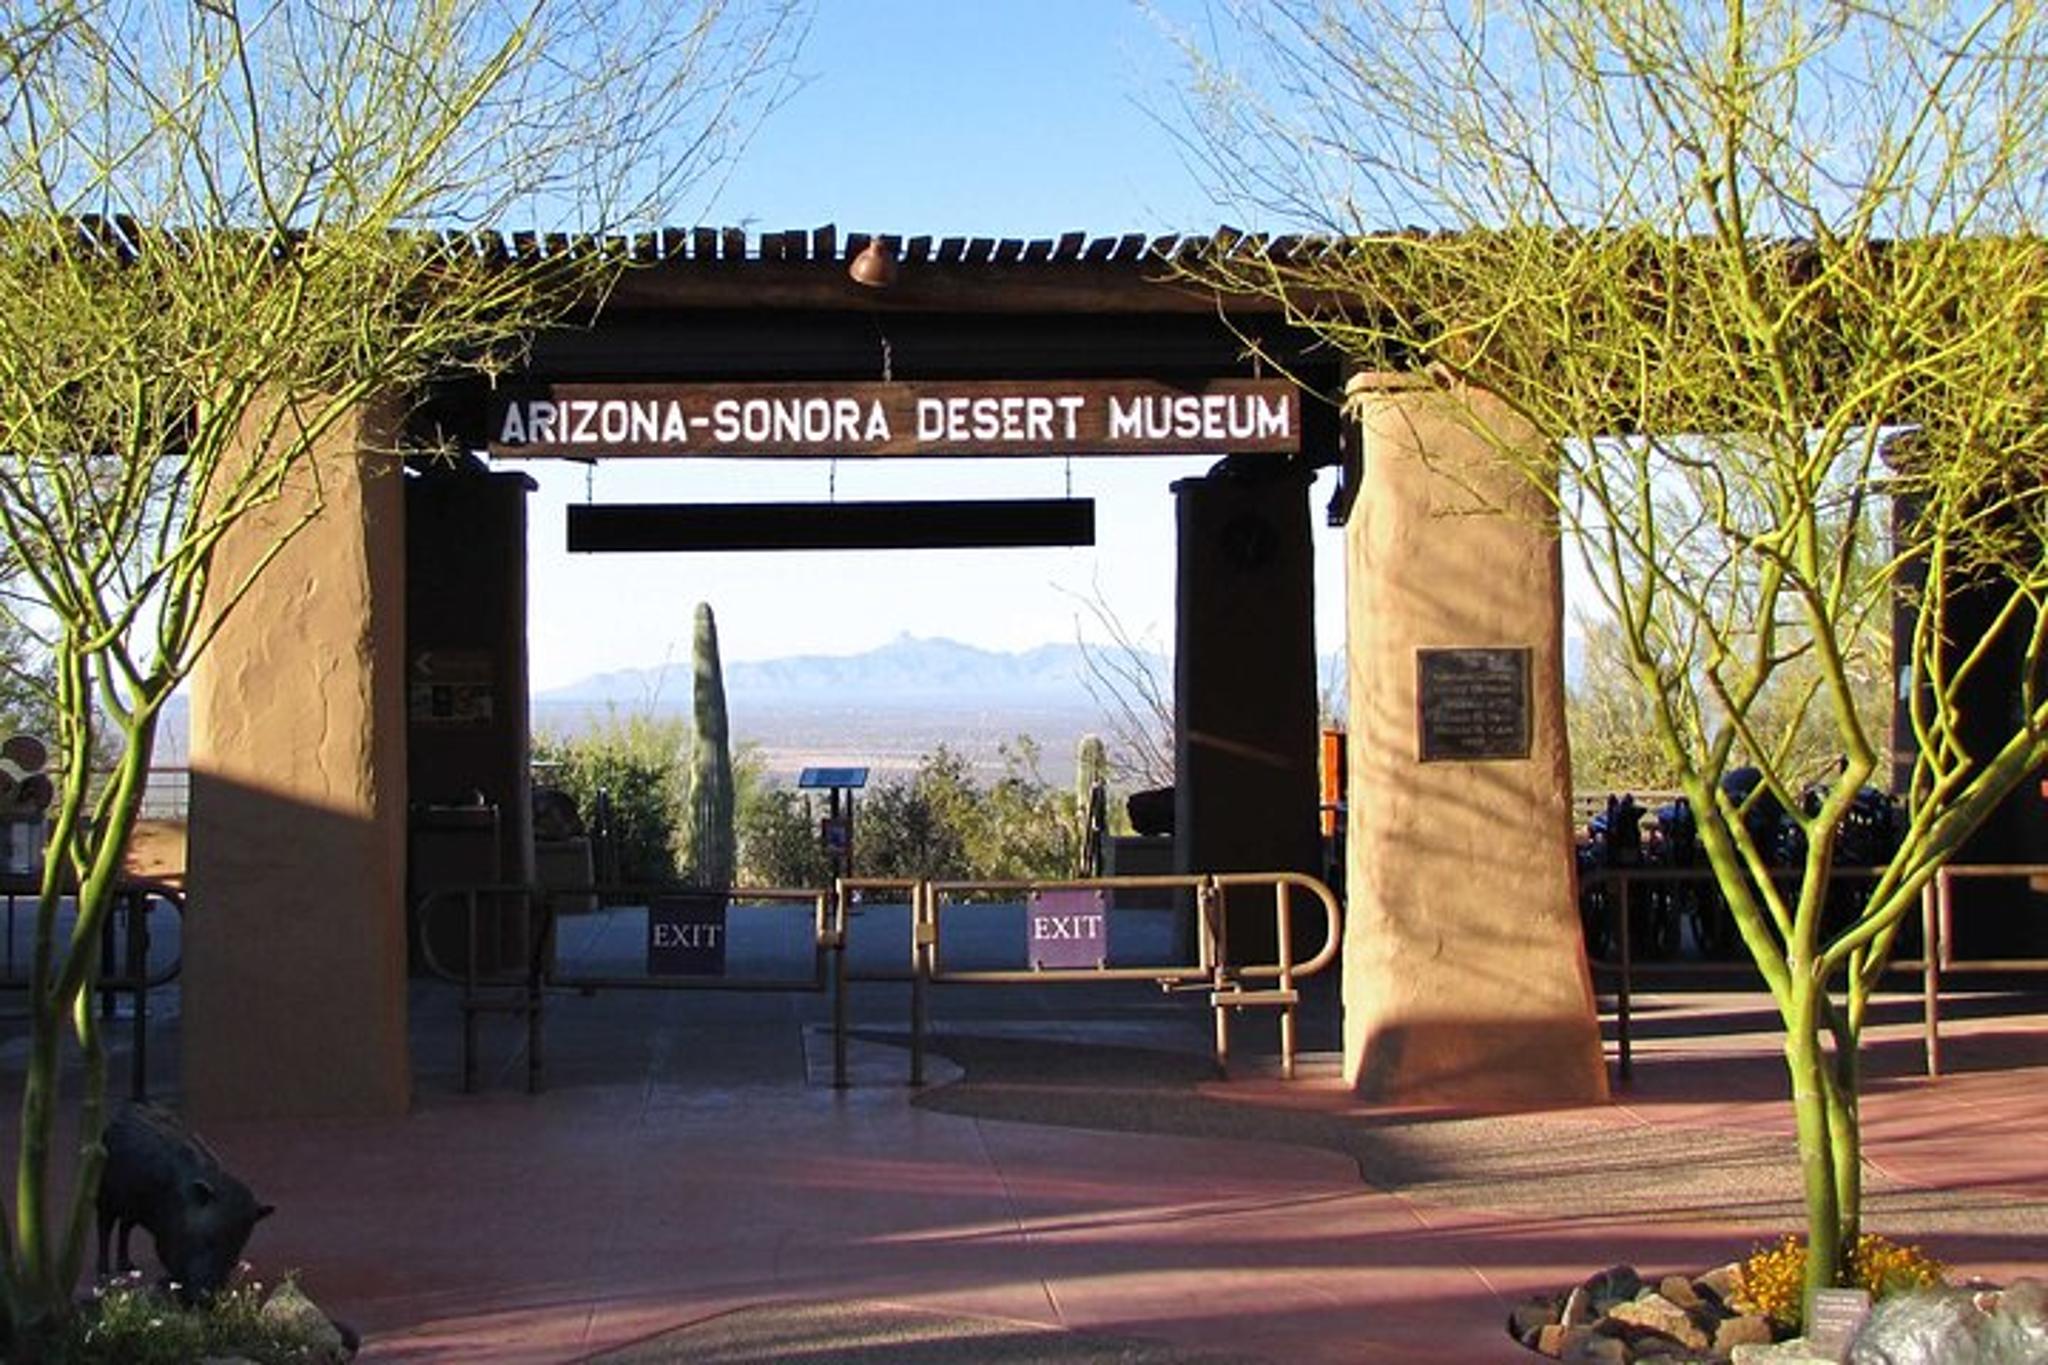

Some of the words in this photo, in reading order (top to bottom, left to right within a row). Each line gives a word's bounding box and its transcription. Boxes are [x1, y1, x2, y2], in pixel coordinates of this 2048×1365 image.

[500, 399, 891, 443] ARIZONA-SONORA
[917, 397, 1085, 441] DESERT
[1110, 395, 1290, 440] MUSEUM
[653, 923, 723, 948] EXIT
[1034, 915, 1102, 940] EXIT
